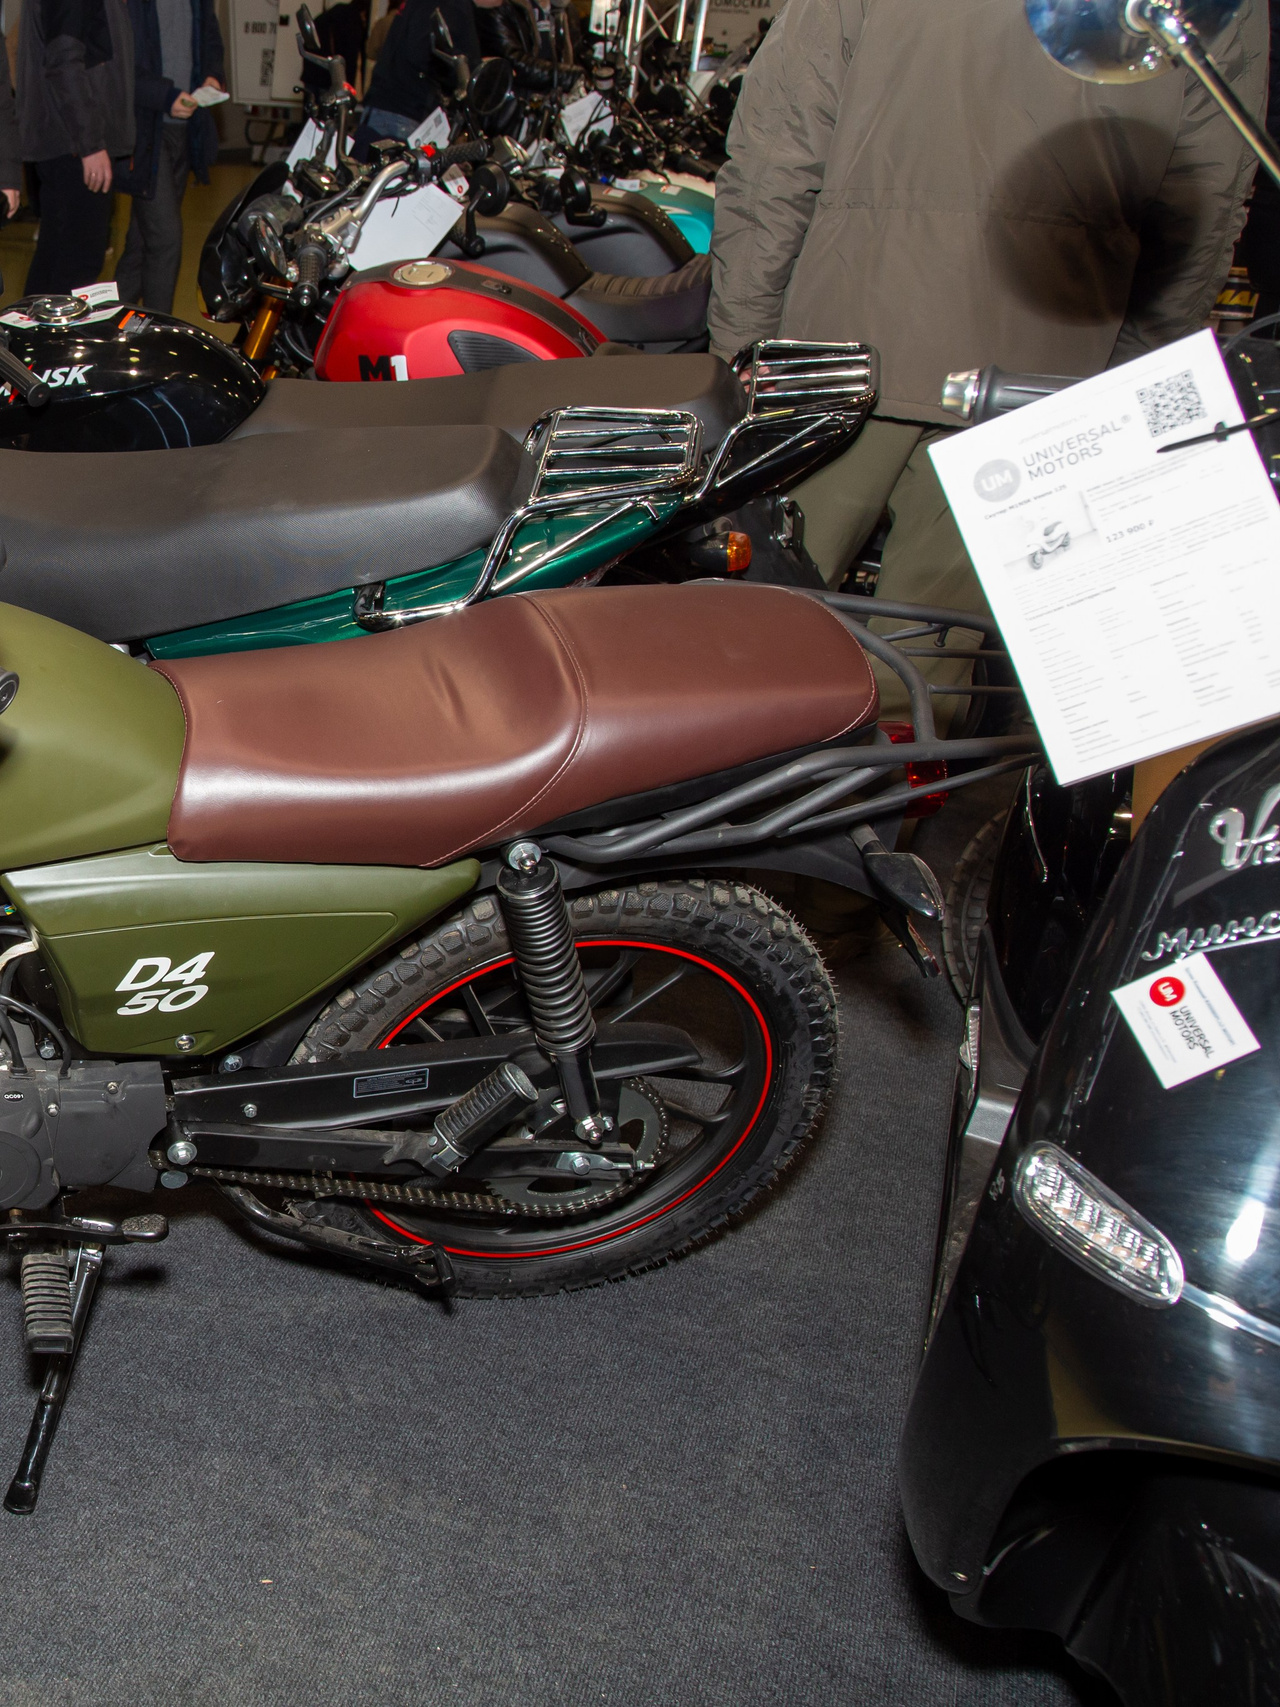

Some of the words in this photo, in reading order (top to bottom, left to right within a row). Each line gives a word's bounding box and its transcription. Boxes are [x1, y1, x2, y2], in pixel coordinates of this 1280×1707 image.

[357, 354, 409, 382] M1
[1028, 442, 1103, 481] MOTORS
[980, 469, 1014, 492] UM
[1105, 530, 1125, 543] 123
[115, 951, 215, 992] D4
[116, 984, 209, 1015] 50
[1157, 981, 1178, 1002] UM
[1169, 1010, 1197, 1051] MOTORS
[1179, 1005, 1214, 1058] UNIVERSAL
